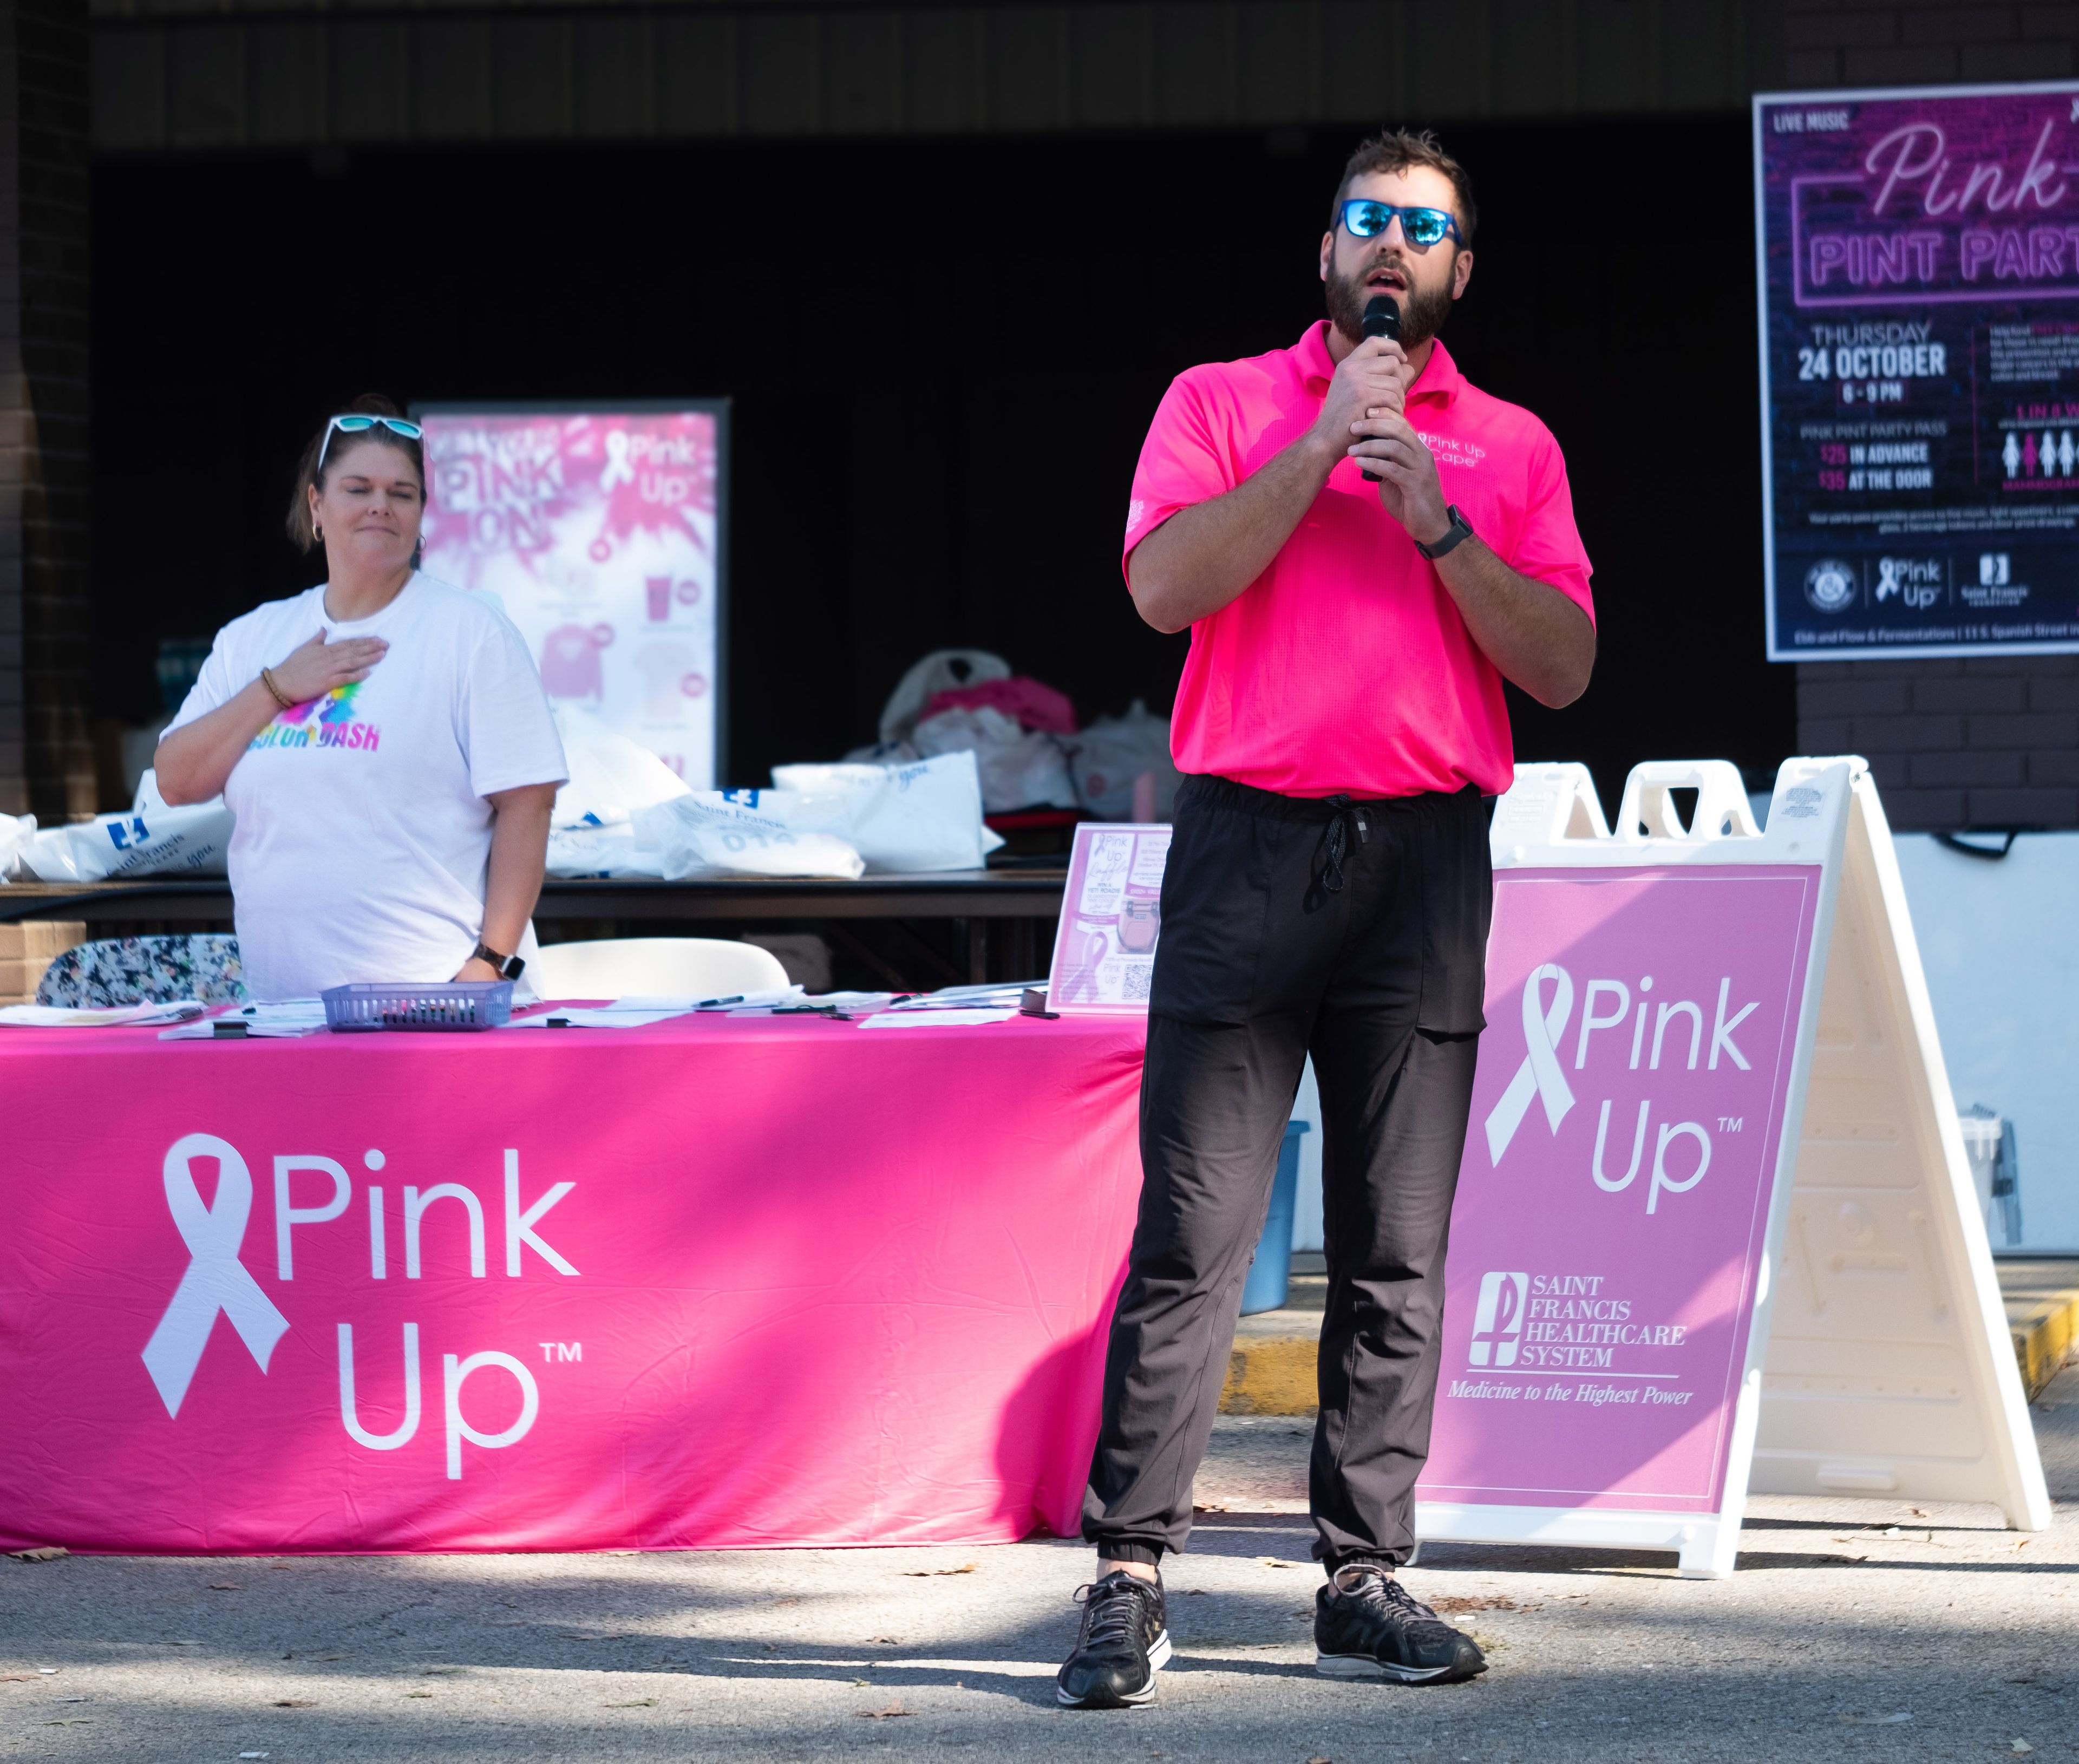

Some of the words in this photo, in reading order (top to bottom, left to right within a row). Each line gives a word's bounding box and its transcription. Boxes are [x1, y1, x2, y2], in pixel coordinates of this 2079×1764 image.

[1774, 112, 1804, 132] LIVE
[1807, 110, 1849, 131] MUSIC
[1866, 118, 2065, 215] Pink
[1810, 233, 1943, 286] PINT
[1812, 323, 1932, 347] THURSDAY
[1799, 347, 1829, 380] 24
[1835, 344, 1946, 378] OCTOBER
[1880, 381, 1903, 402] PM
[1869, 421, 1911, 437] PARTY
[1914, 420, 1947, 437] PASS
[631, 435, 696, 465] Pink
[1428, 436, 1460, 451] Pink
[1465, 443, 1486, 459] Up
[1820, 443, 1848, 465] $25
[1849, 443, 1866, 465] IN
[1868, 441, 1928, 464] ADVANCE
[640, 473, 690, 505] Up
[1819, 469, 1846, 491] $35
[1848, 469, 1866, 491] AT
[1867, 468, 1893, 491] THE
[1895, 467, 1933, 489] DOOR
[1896, 558, 1941, 582] Pink
[1904, 585, 1937, 609] Up
[1991, 623, 2032, 639] Spanish
[2034, 622, 2068, 637] Street
[316, 722, 380, 752] DASH
[694, 801, 729, 816] Saint
[735, 810, 787, 828] Francis
[1106, 836, 1128, 847] Pink
[1103, 963, 1121, 973] Pink
[1575, 976, 1761, 1070] Pink
[1592, 1100, 1711, 1214] Up
[273, 1149, 581, 1281] Pink
[1532, 1275, 1604, 1296] SAINT
[1528, 1299, 1631, 1321] FRANCIS
[1524, 1323, 1688, 1345] HEALTHCARE
[1520, 1346, 1614, 1367] SYSTEM
[337, 1322, 540, 1480] Up
[1447, 1380, 1521, 1400] Medicine
[1524, 1383, 1540, 1400] to
[1545, 1382, 1571, 1402] the
[1574, 1384, 1638, 1407] Highest
[1641, 1387, 1694, 1405] Power
